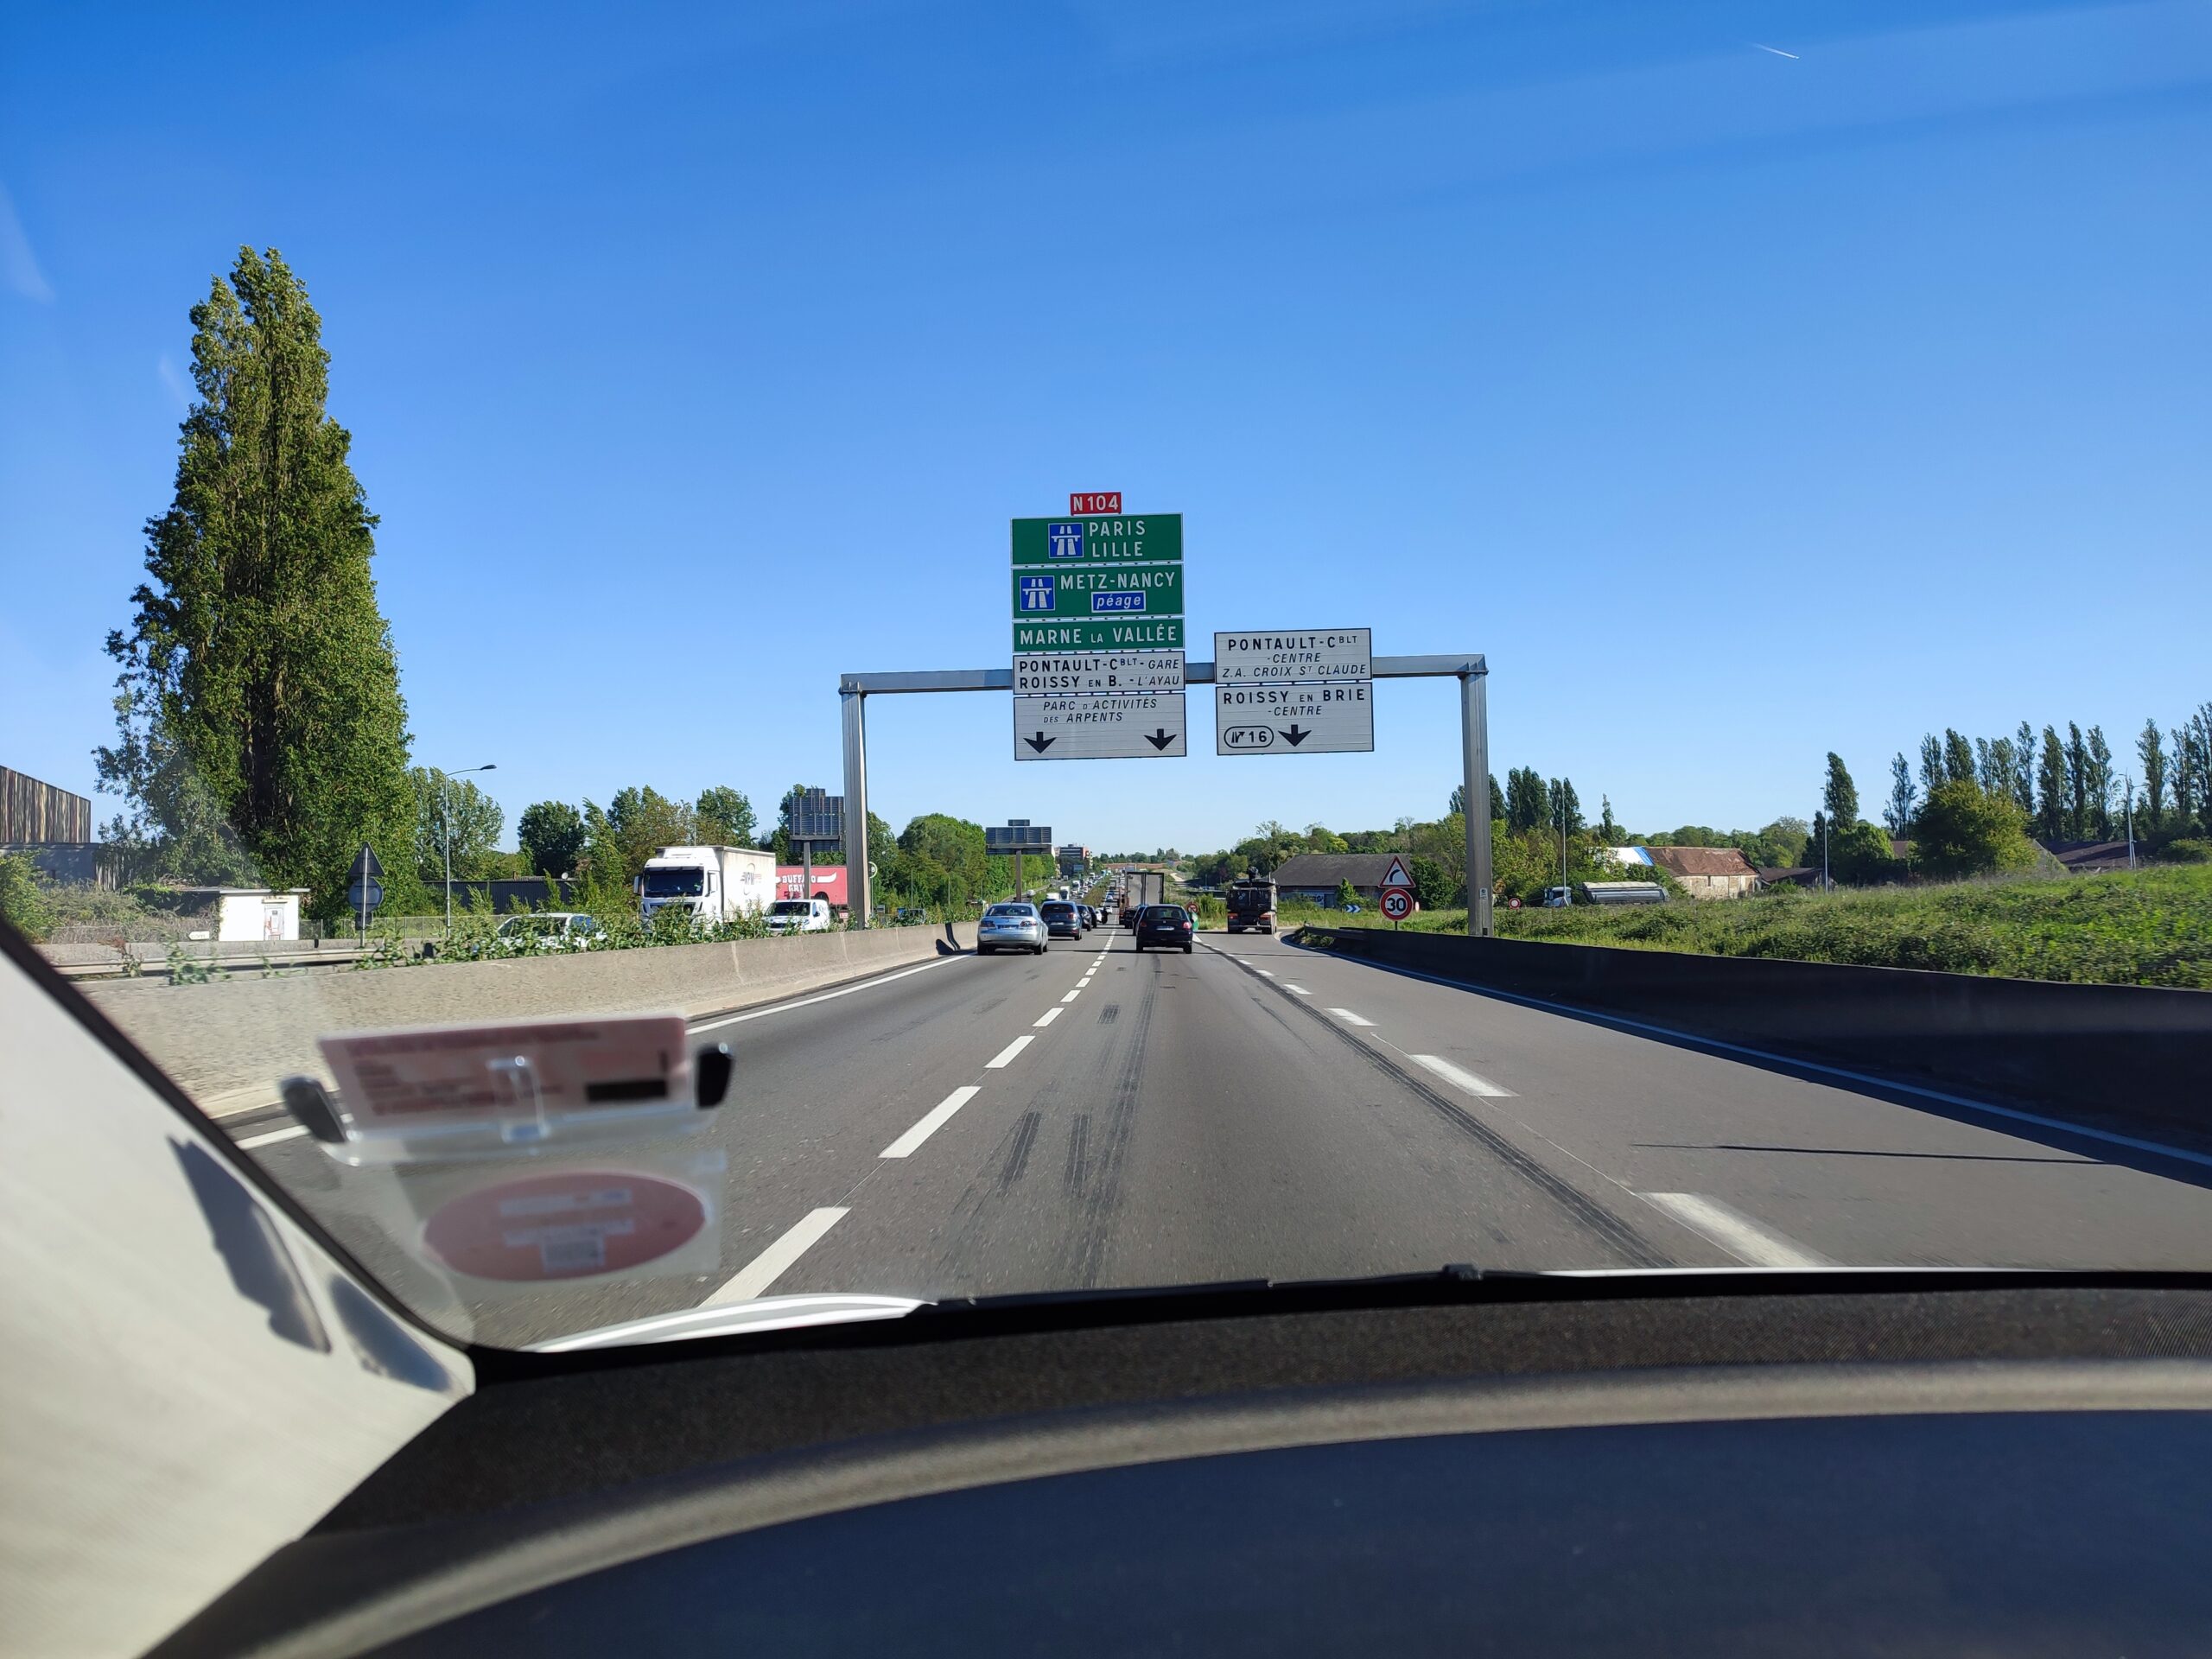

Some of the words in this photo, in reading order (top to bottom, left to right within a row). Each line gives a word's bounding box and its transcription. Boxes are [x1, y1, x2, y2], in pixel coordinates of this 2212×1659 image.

[1089, 520, 1146, 537] PARIS
[1092, 541, 1143, 557] LILLE
[1060, 572, 1175, 589] METZ-NANCY
[1096, 594, 1141, 609] péage
[1020, 629, 1082, 645] MARNE
[1090, 633, 1103, 643] LA
[1113, 623, 1177, 643] VALLÉE
[1223, 668, 1246, 677] Z.A.
[1254, 666, 1293, 677] CROIX
[1318, 664, 1366, 675] CLAUDE
[1020, 677, 1080, 689] ROISSY
[1088, 679, 1101, 688] EN
[1224, 691, 1289, 704] ROISSY
[1323, 689, 1365, 702] BRIE
[1043, 701, 1076, 711] PARC
[1066, 712, 1123, 723] ARPENTS
[1249, 731, 1268, 742] 16
[1386, 897, 1407, 912] 30
